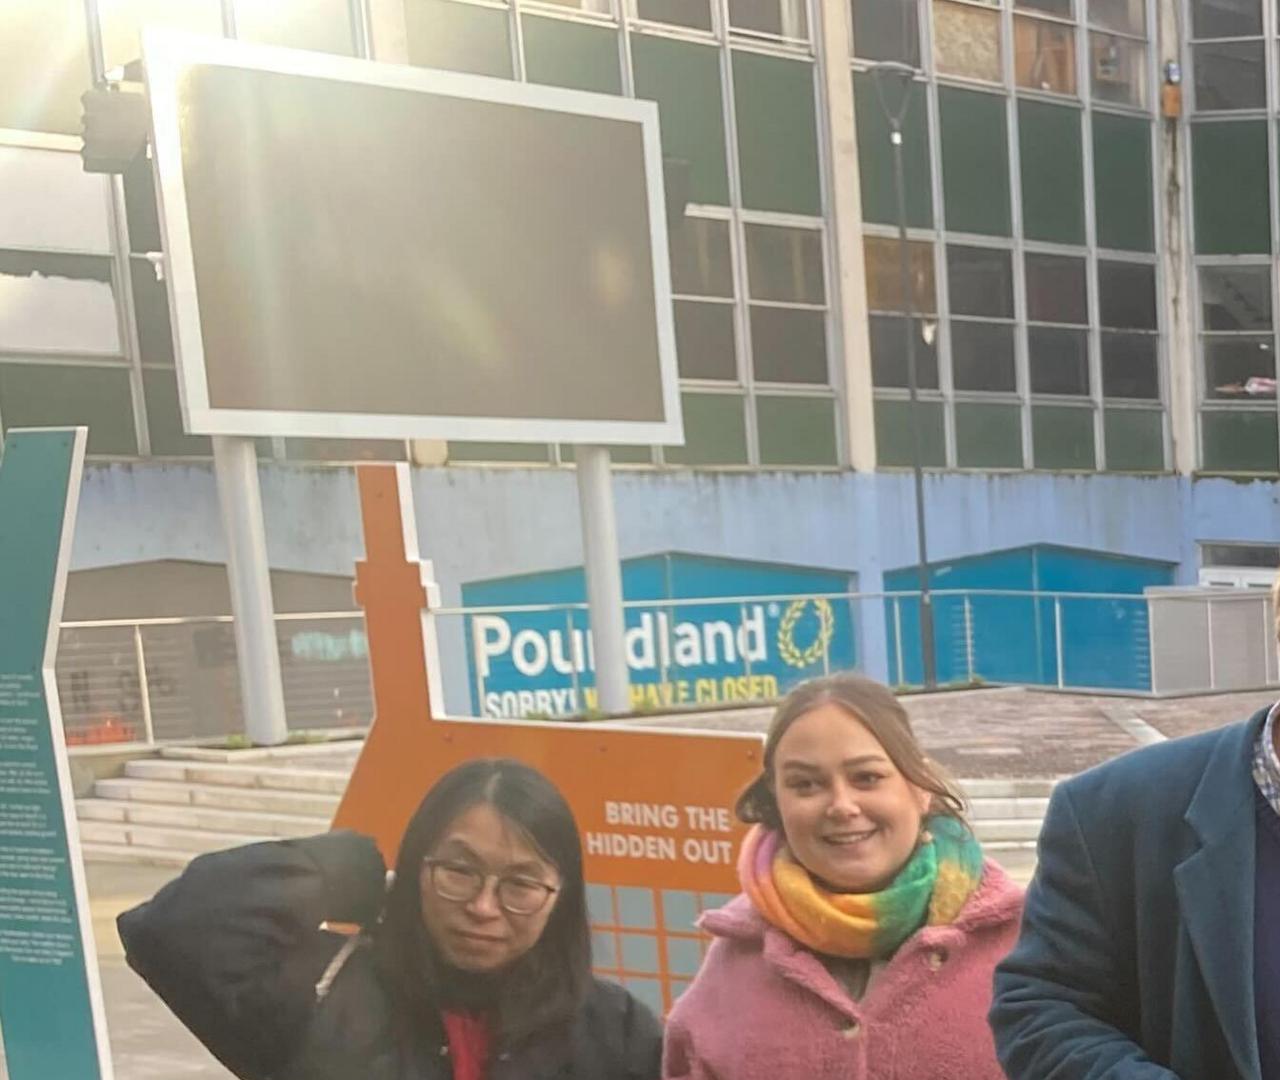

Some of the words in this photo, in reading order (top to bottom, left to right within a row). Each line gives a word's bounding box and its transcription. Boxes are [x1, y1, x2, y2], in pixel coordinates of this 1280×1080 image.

[472, 601, 768, 677] Poudland
[604, 801, 680, 829] BRING
[684, 805, 732, 832] THE
[585, 831, 677, 861] HIDDEN
[683, 838, 733, 865] OUT
